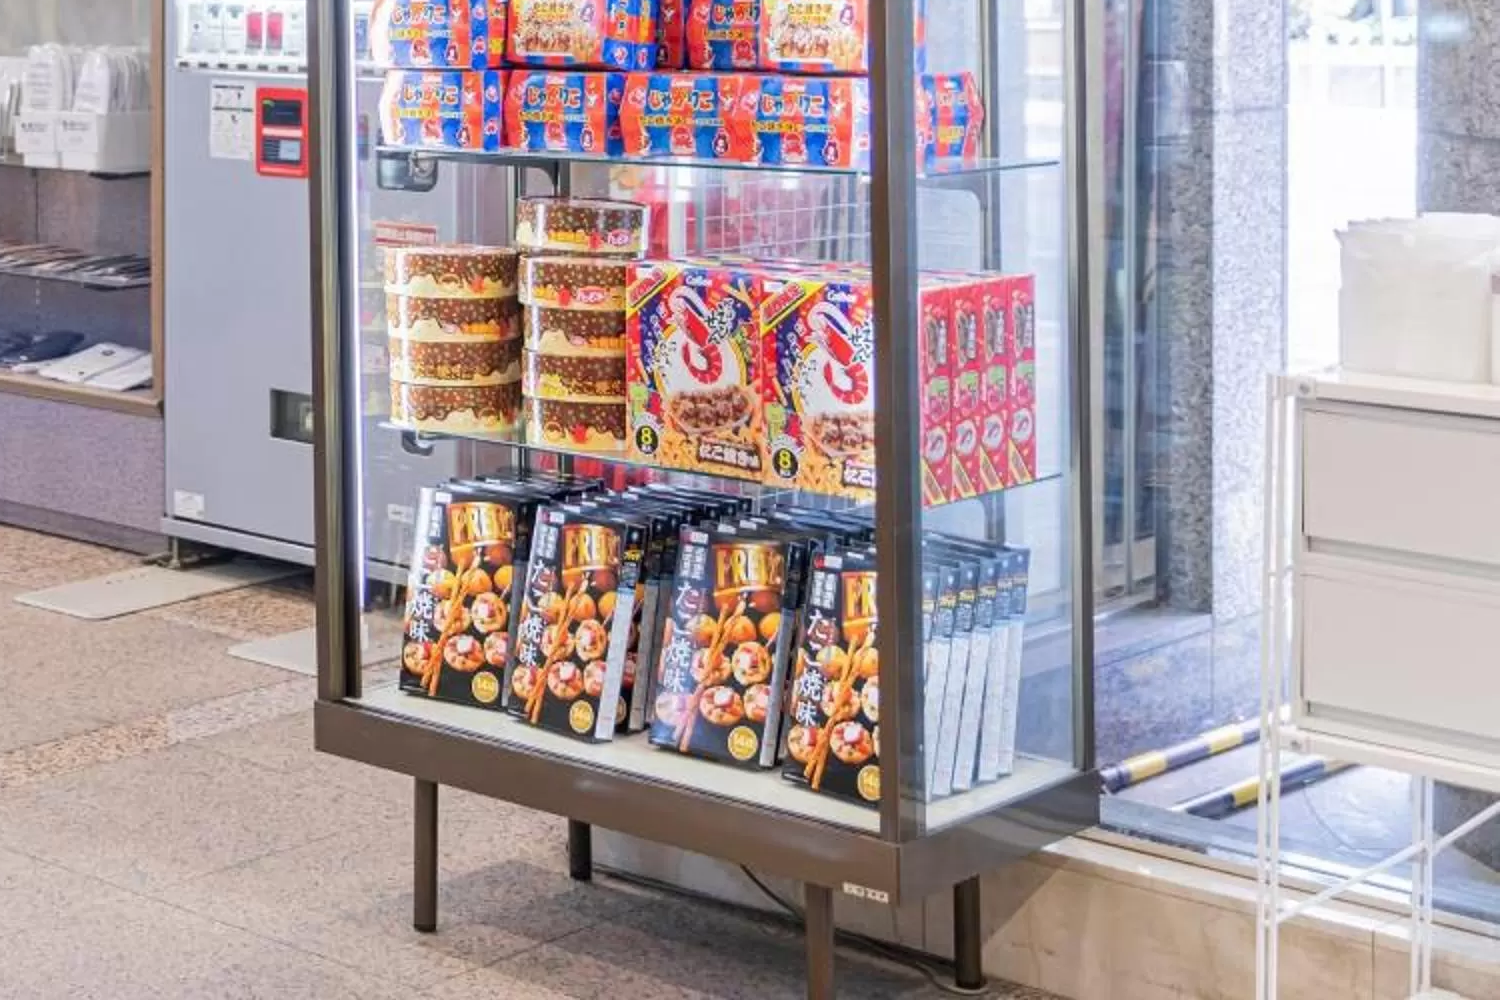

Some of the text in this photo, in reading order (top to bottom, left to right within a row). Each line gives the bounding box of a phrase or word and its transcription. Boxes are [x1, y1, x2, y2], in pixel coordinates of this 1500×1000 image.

[713, 1, 760, 25] じゃがり
[641, 427, 653, 446] 8
[779, 451, 792, 470] 8
